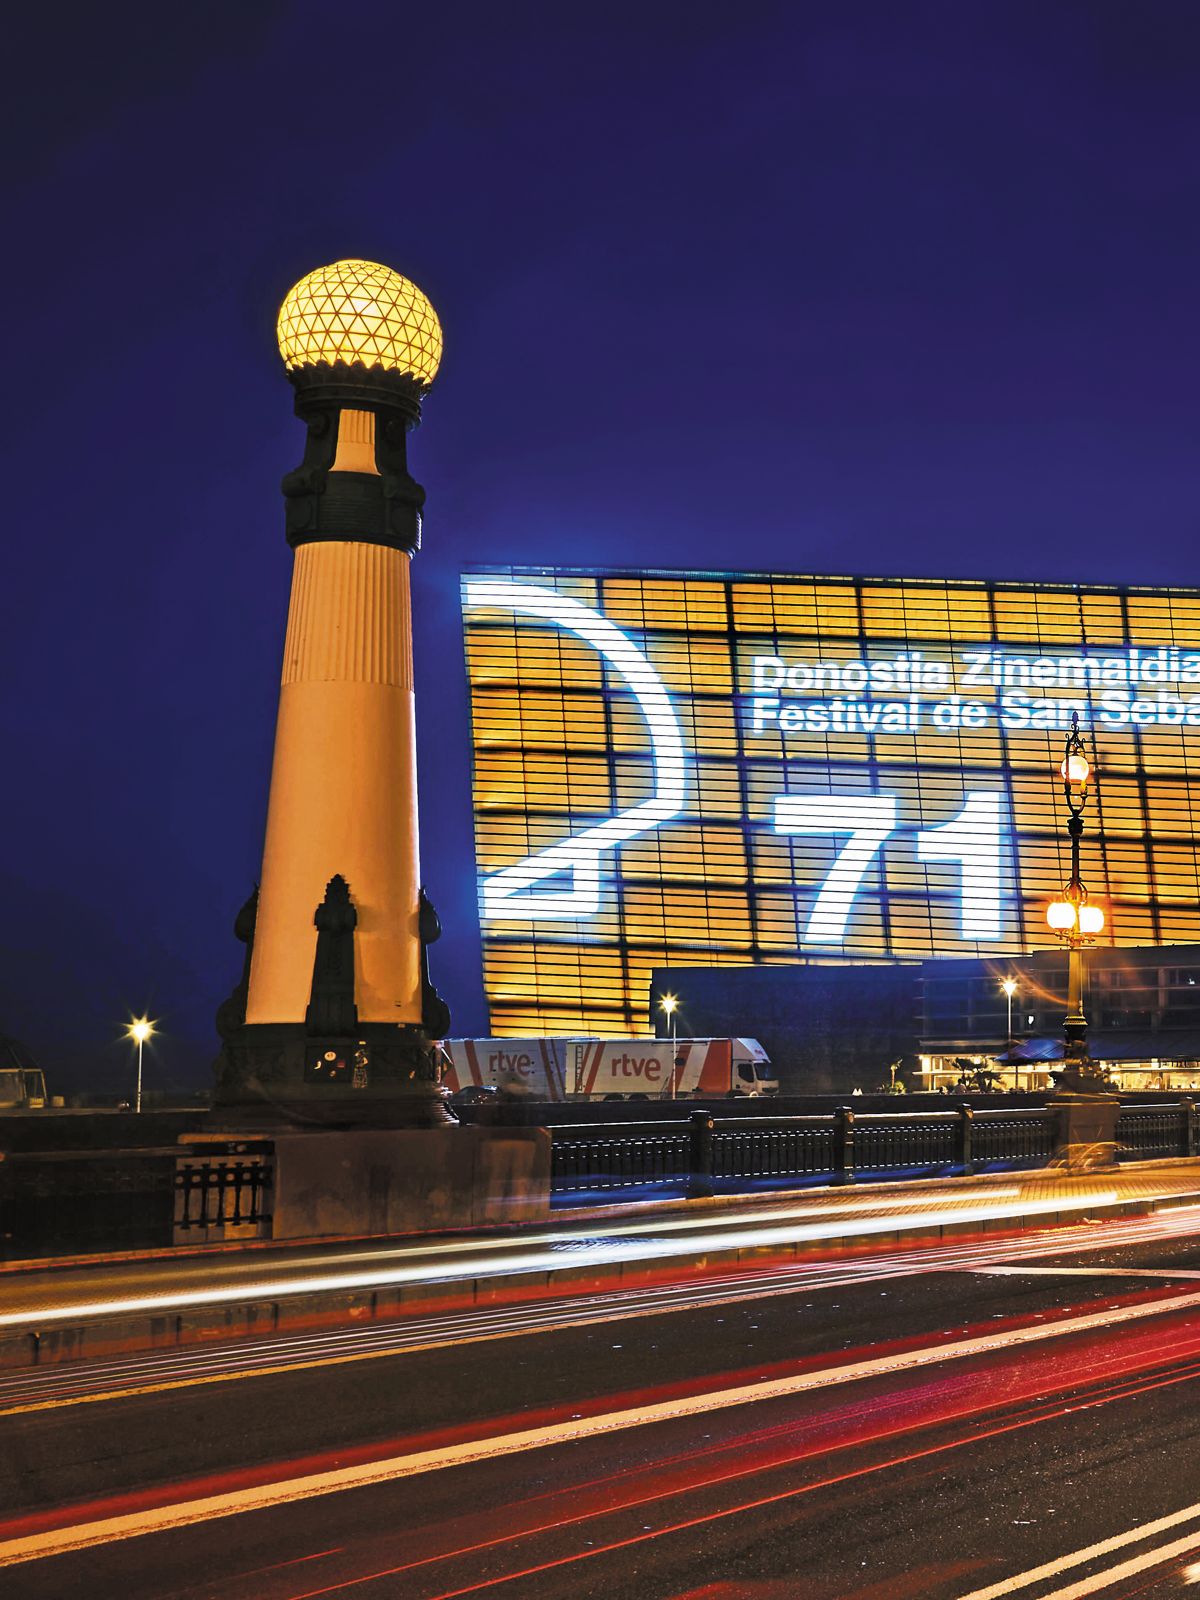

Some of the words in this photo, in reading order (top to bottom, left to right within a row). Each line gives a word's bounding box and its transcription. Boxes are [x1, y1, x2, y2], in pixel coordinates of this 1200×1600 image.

[752, 651, 948, 693] Donostia
[753, 692, 919, 734] Festival
[932, 694, 987, 730] de
[1000, 690, 1089, 729] San
[773, 792, 1002, 942] 71
[489, 1051, 531, 1077] rtve
[611, 1053, 661, 1081] rtve
